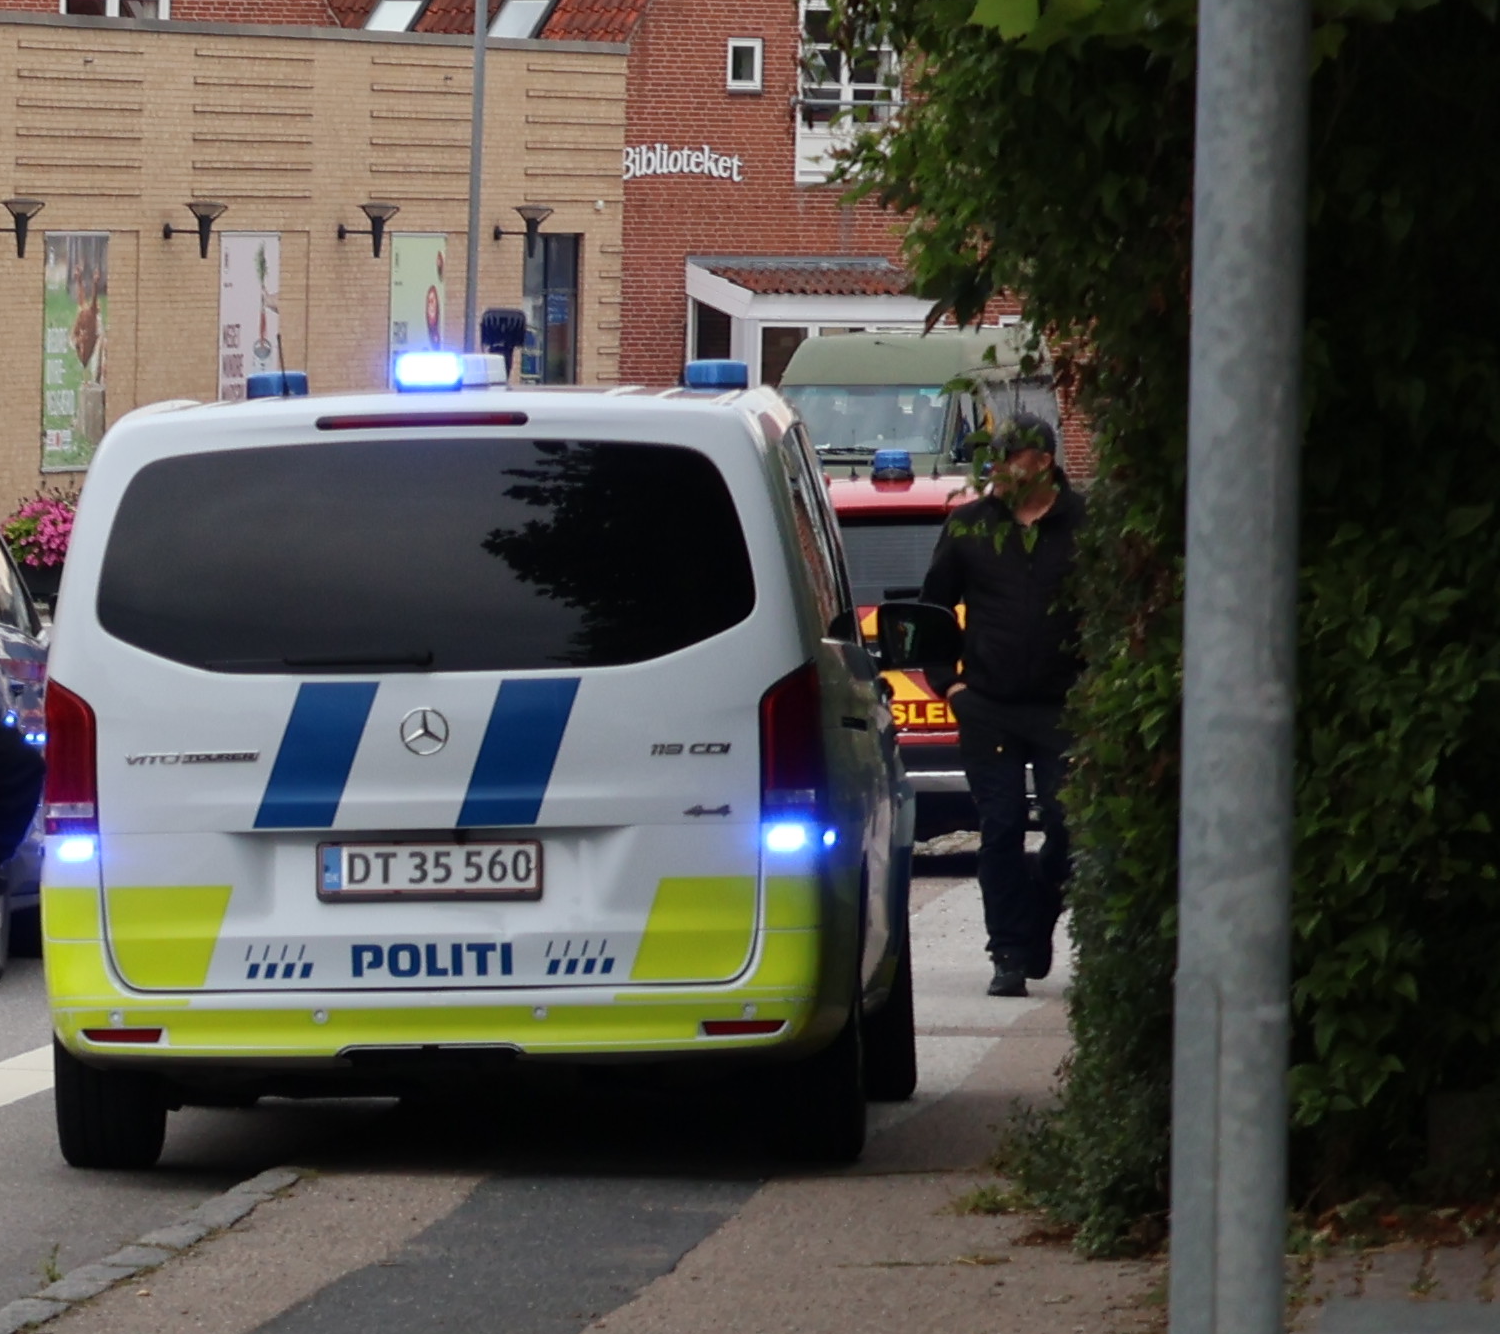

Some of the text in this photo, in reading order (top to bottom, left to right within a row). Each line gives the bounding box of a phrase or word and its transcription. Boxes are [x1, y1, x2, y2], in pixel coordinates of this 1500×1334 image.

[622, 143, 744, 183] Biblioteket
[125, 752, 180, 765] VITO
[689, 743, 732, 755] CDI
[348, 849, 533, 885] DT 35 560
[351, 942, 513, 979] POLITI
